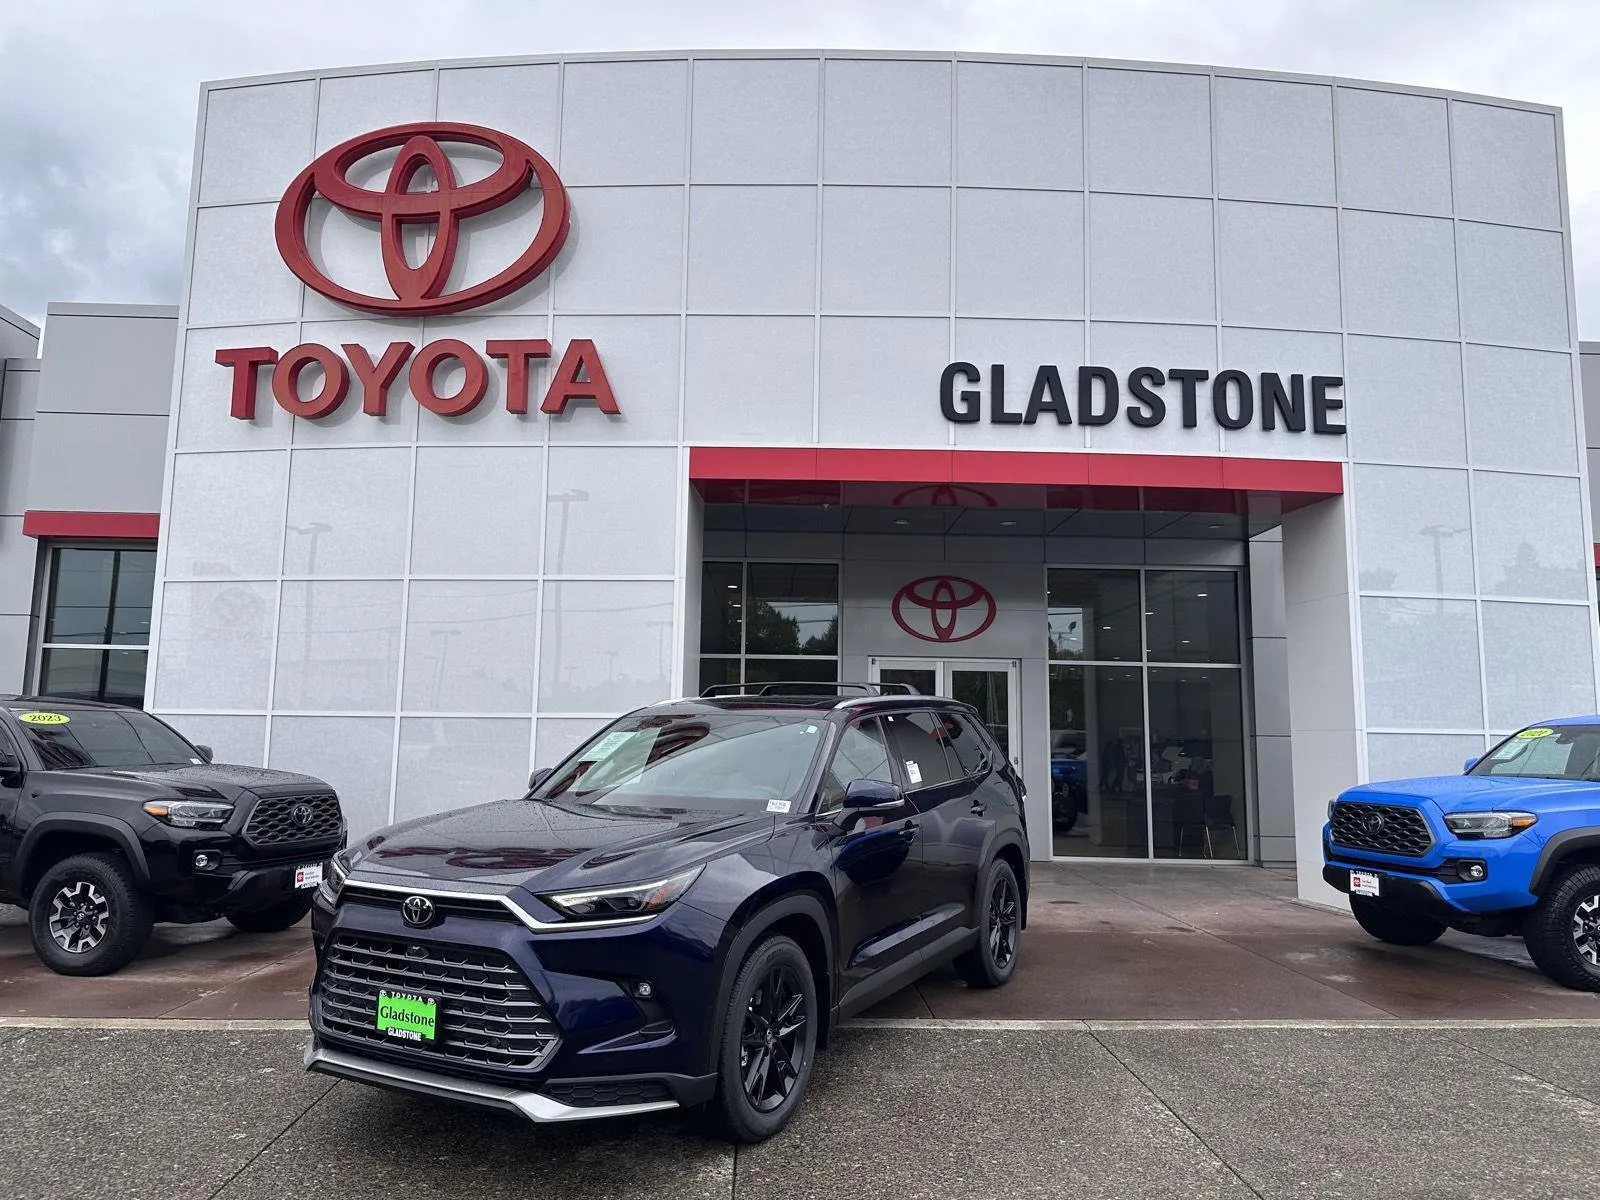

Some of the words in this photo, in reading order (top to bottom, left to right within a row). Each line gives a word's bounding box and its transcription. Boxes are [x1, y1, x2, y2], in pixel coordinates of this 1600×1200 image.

[215, 338, 620, 420] TOYOTA
[939, 361, 1347, 437] GLADSTONE
[29, 714, 62, 722] 2023
[391, 991, 423, 1002] TOYOTA
[380, 1005, 434, 1027] Gladstone
[387, 1027, 422, 1041] GLADSTONE
